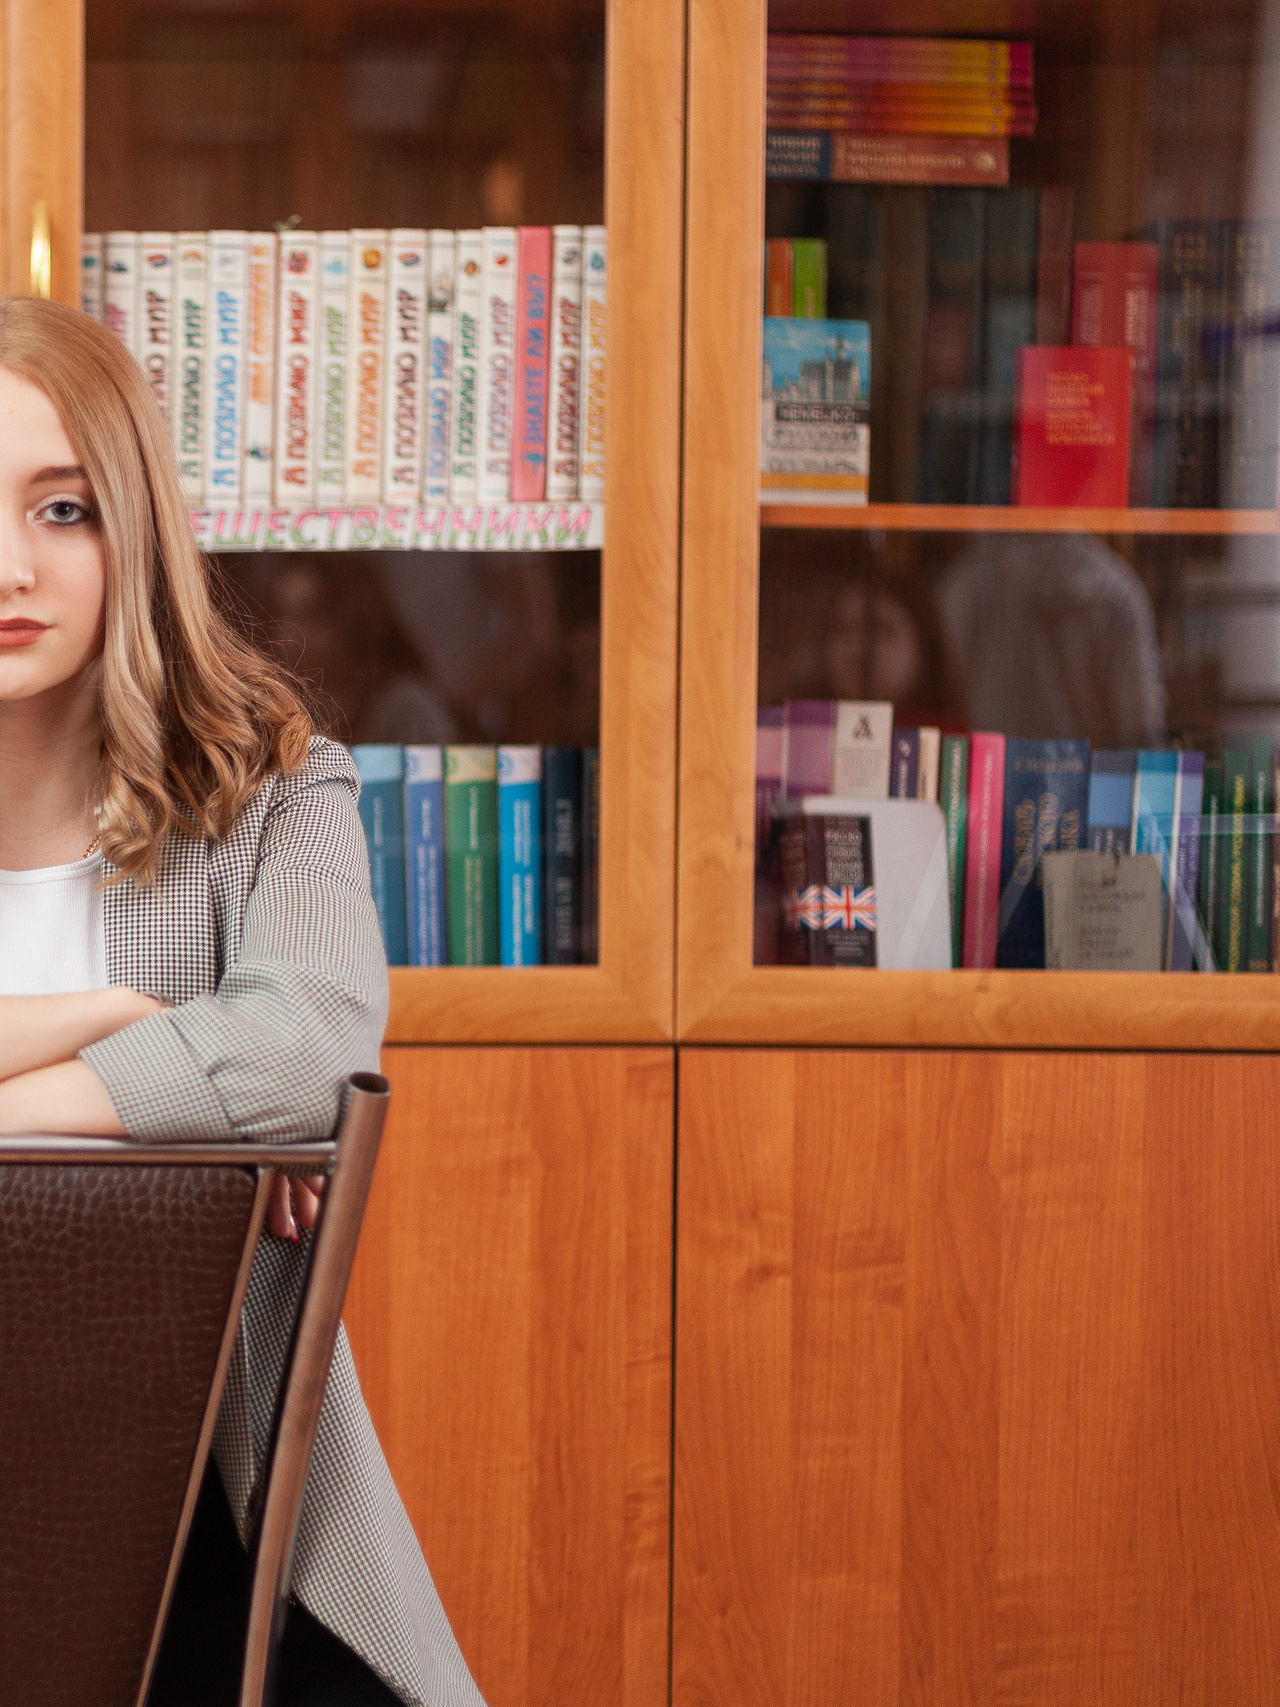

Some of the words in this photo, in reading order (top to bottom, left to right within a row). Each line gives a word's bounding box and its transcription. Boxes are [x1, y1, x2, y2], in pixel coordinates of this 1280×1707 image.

[146, 290, 166, 344] МИР
[183, 298, 202, 348] МИР
[217, 291, 238, 346] МИР
[290, 292, 307, 344] МИР
[325, 306, 344, 356] МИР
[361, 292, 379, 344] МИР
[398, 288, 418, 343] МИР
[461, 312, 478, 359] МИР
[526, 327, 545, 358] ЛИ
[561, 298, 580, 347] МИР
[181, 355, 202, 453] ПОЗНАЮ
[215, 354, 237, 460] ПОЗНАЮ
[287, 353, 307, 459] ПОЗНАЮ
[323, 363, 344, 461] ПОЗНАЮ
[356, 352, 379, 453] ПОЗНАЮ
[395, 352, 417, 458] ПОЗНАЮ
[457, 365, 476, 455] ПОЗНАЮ
[524, 367, 545, 445] ЗНАЕТЕ
[558, 353, 578, 452] ПОЗНАЮ
[189, 508, 590, 547] ЕШЕСТВЕННИКИ
